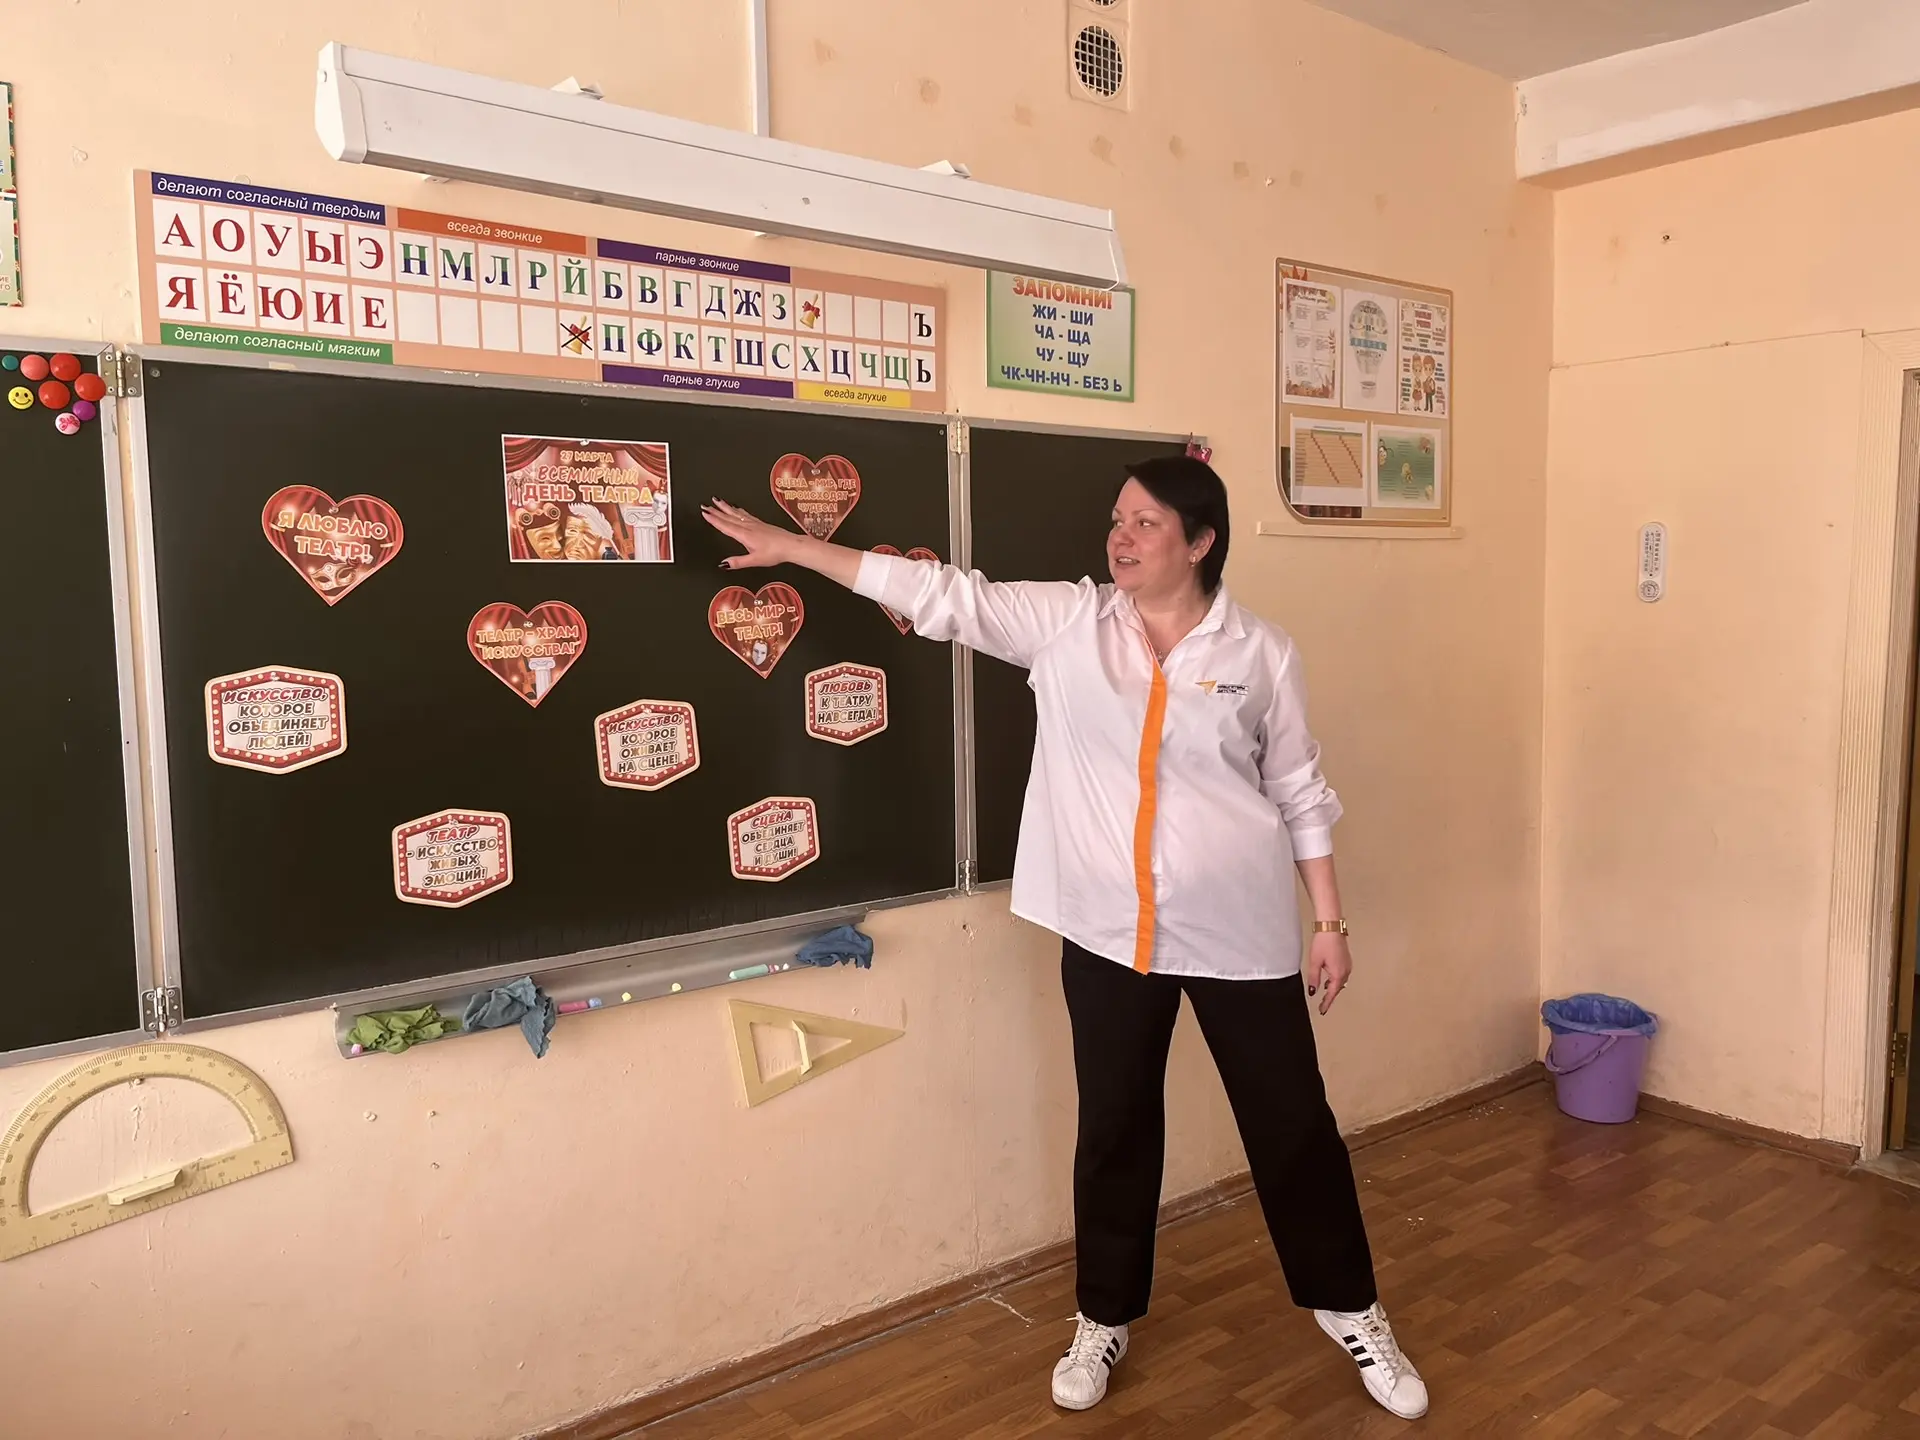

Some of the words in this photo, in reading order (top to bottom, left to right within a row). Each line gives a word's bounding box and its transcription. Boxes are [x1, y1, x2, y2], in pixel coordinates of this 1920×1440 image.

[156, 178, 222, 199] делают
[226, 187, 309, 211] согласный
[312, 199, 381, 221] твердым
[447, 219, 491, 237] всегда
[494, 228, 543, 245] звонкие
[655, 250, 696, 267] парные
[699, 256, 740, 273] звонкие
[162, 213, 195, 248] А
[212, 218, 245, 252] О
[257, 223, 292, 257] У
[304, 230, 345, 266] Ы
[358, 237, 384, 270] Э
[400, 242, 430, 277] Н
[440, 249, 474, 282] М
[485, 256, 511, 286] Л
[528, 260, 548, 290] Р
[562, 259, 588, 296] Й
[602, 271, 624, 300] Б
[638, 275, 658, 304] В
[673, 280, 692, 308] Г
[705, 284, 727, 319] Д
[733, 288, 761, 318] Ж
[772, 293, 787, 321] З
[914, 311, 932, 338] Ъ
[1012, 276, 1113, 310] ЗАПОМНИ!
[1032, 304, 1057, 320] ЖИ
[1070, 310, 1094, 326] ШИ
[166, 277, 196, 310] Я
[218, 273, 246, 314] Ё
[261, 286, 303, 321] Ю
[313, 291, 345, 326] И
[363, 297, 387, 329] Е
[602, 323, 627, 353] П
[637, 327, 662, 355] Ф
[673, 332, 694, 359] К
[707, 335, 727, 362] Т
[734, 338, 764, 367] Ш
[771, 343, 791, 370] С
[801, 346, 821, 373] Х
[830, 348, 851, 382] Ц
[859, 352, 879, 378] Ч
[884, 354, 910, 386] Щ
[915, 358, 932, 383] Ь
[1034, 324, 1055, 340] ЧА
[1067, 329, 1091, 346] ЩА
[175, 327, 239, 347] делают
[243, 333, 324, 354] согласный
[328, 343, 381, 359] мягким
[1036, 347, 1055, 362] ЧУ
[1067, 351, 1090, 368] ЩУ
[662, 372, 703, 389] парные
[705, 376, 741, 392] глухие
[1000, 365, 1071, 387] ЧК-ЧН-НЧ
[1083, 375, 1109, 391] БЕЗ
[1113, 379, 1123, 392] Ь
[824, 387, 855, 403] всегда
[857, 390, 888, 403] глухие
[560, 450, 573, 462] 27
[574, 452, 614, 463] МАРТА
[537, 465, 639, 485] ВСЕМИРНЫЙ
[523, 483, 576, 503] ДЕНЬ
[579, 485, 653, 504] ТЕАТРА
[785, 491, 849, 502] ПРОИСХОДЯТ
[278, 511, 295, 529] Я
[297, 512, 388, 540] ЛЮБЛЮ
[294, 535, 371, 561] ТЕАТР!
[717, 608, 753, 624] ВЕСЬ
[754, 604, 786, 620] МИР
[476, 628, 524, 643] ТЕАТР
[536, 625, 579, 640] ХРАМ
[734, 622, 784, 641] ТЕАТР!
[482, 641, 576, 660] ИСКУССТВА!
[224, 688, 328, 703] ИСКУССТВО,
[820, 681, 872, 694] ЛЮБОВЬ
[240, 703, 313, 717] КОТОРОЕ
[821, 698, 829, 708] К
[833, 695, 872, 707] ТЕАТРУ
[228, 717, 327, 733] ОБЪЕДИНЯЕТ
[608, 714, 683, 733] ИСКУССТВО,
[818, 709, 877, 723] НАВСЕГДА!
[248, 731, 310, 748] ЛЮДЕЙ!
[622, 728, 676, 746] КОТОРОЕ
[621, 741, 676, 759] ОЖИВАЕТ
[618, 761, 635, 773] НА
[640, 753, 679, 770] СЦЕНЕ!
[752, 810, 793, 828] СЦЕНА
[428, 826, 479, 842] ТЕАТР
[742, 821, 805, 843] ОБЪЕДИНЯЕТ
[417, 838, 497, 858] ИСКУССТВО
[755, 836, 794, 853] СЕРДЦА
[429, 854, 479, 871] ЖИВЫХ
[754, 856, 761, 866] И
[764, 848, 797, 864] ДУШИ!
[424, 867, 487, 887] ЭМОЦИЙ!
